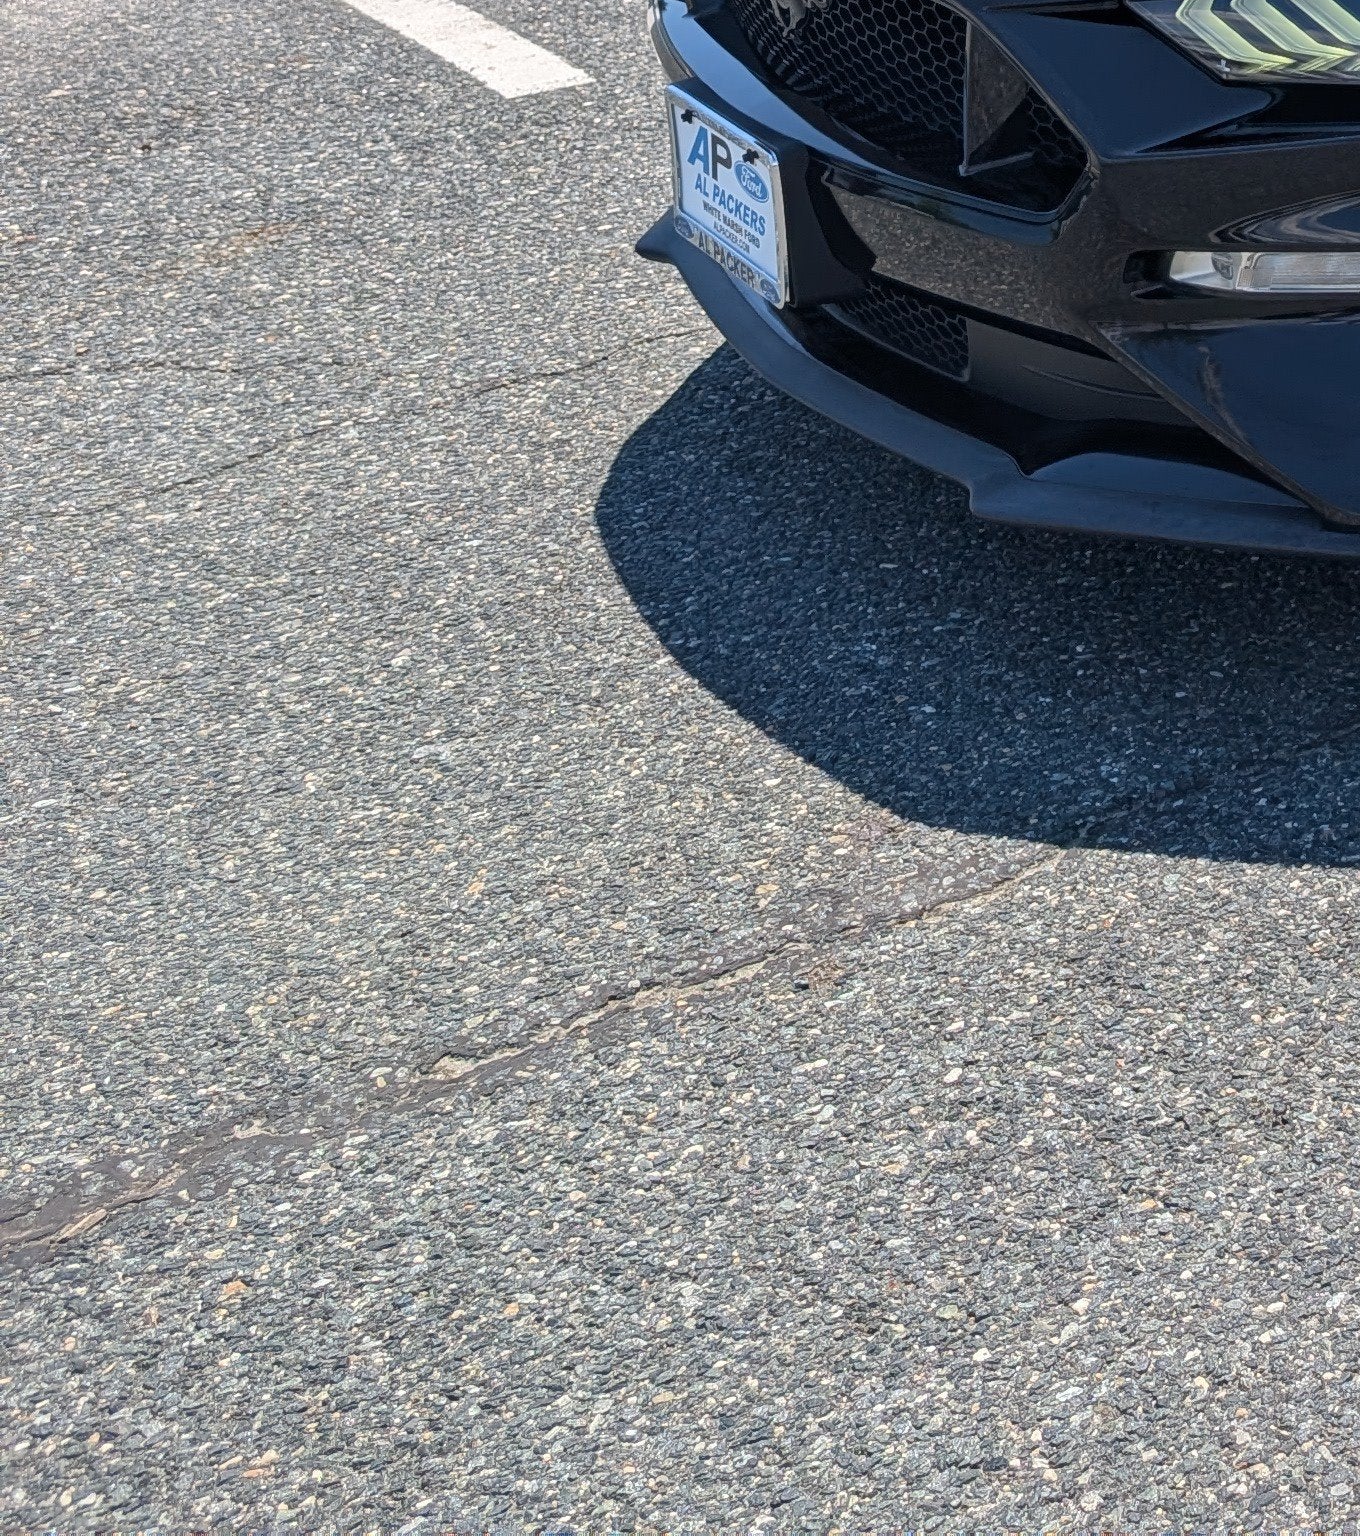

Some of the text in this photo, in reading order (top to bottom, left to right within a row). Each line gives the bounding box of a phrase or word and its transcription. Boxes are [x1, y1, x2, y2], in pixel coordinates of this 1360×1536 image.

[687, 125, 733, 182] AP
[740, 165, 763, 198] Ford
[694, 173, 710, 198] AL
[712, 183, 766, 237] PACKERS
[698, 230, 756, 289] AL PACKER
